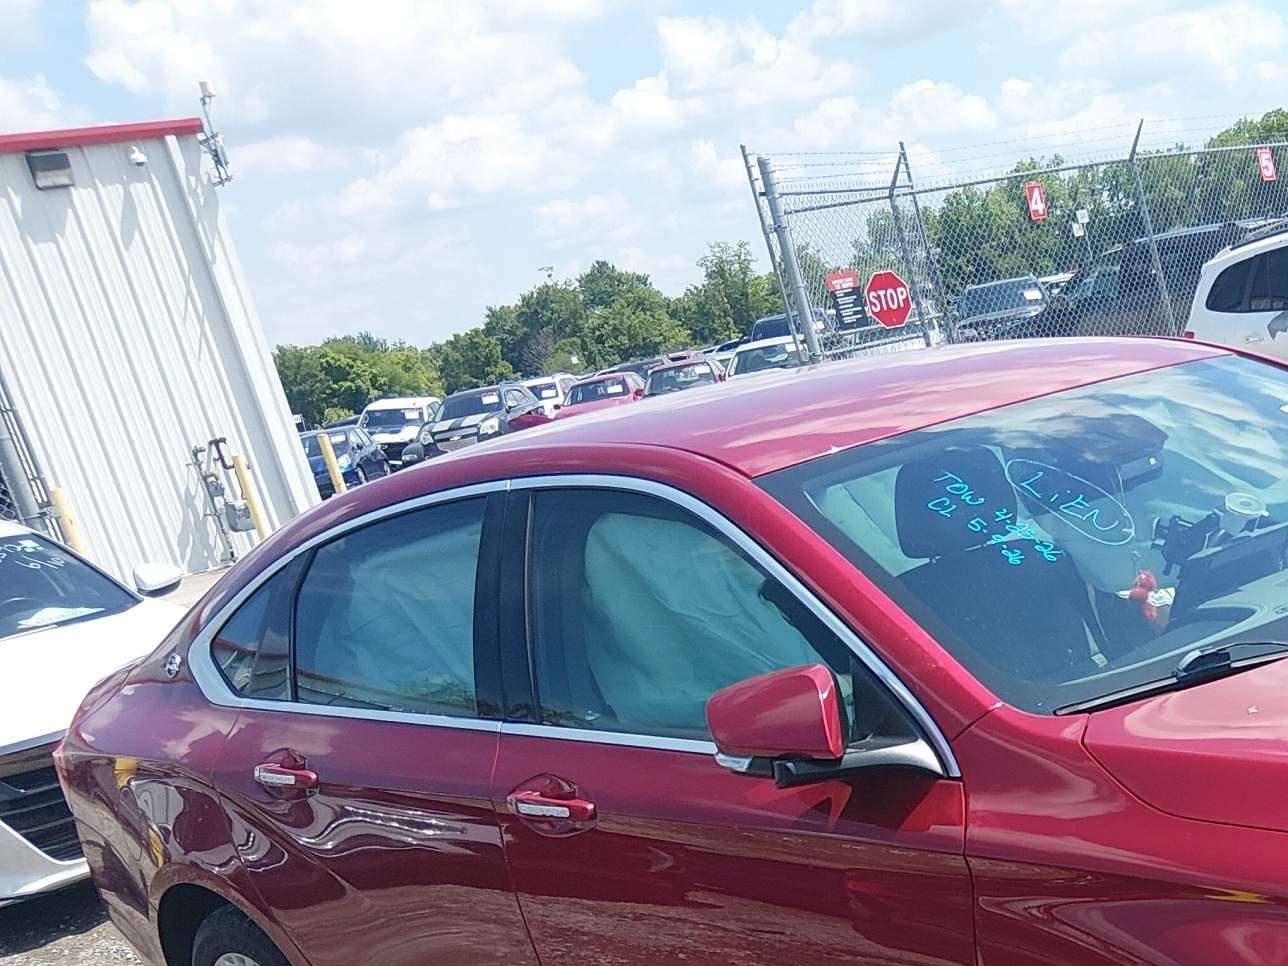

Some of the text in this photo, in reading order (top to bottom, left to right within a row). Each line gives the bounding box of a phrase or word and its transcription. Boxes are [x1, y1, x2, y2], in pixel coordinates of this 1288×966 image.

[1260, 151, 1273, 178] 5
[1031, 187, 1045, 215] 4
[869, 287, 907, 312] STOP
[933, 470, 985, 505] TOW
